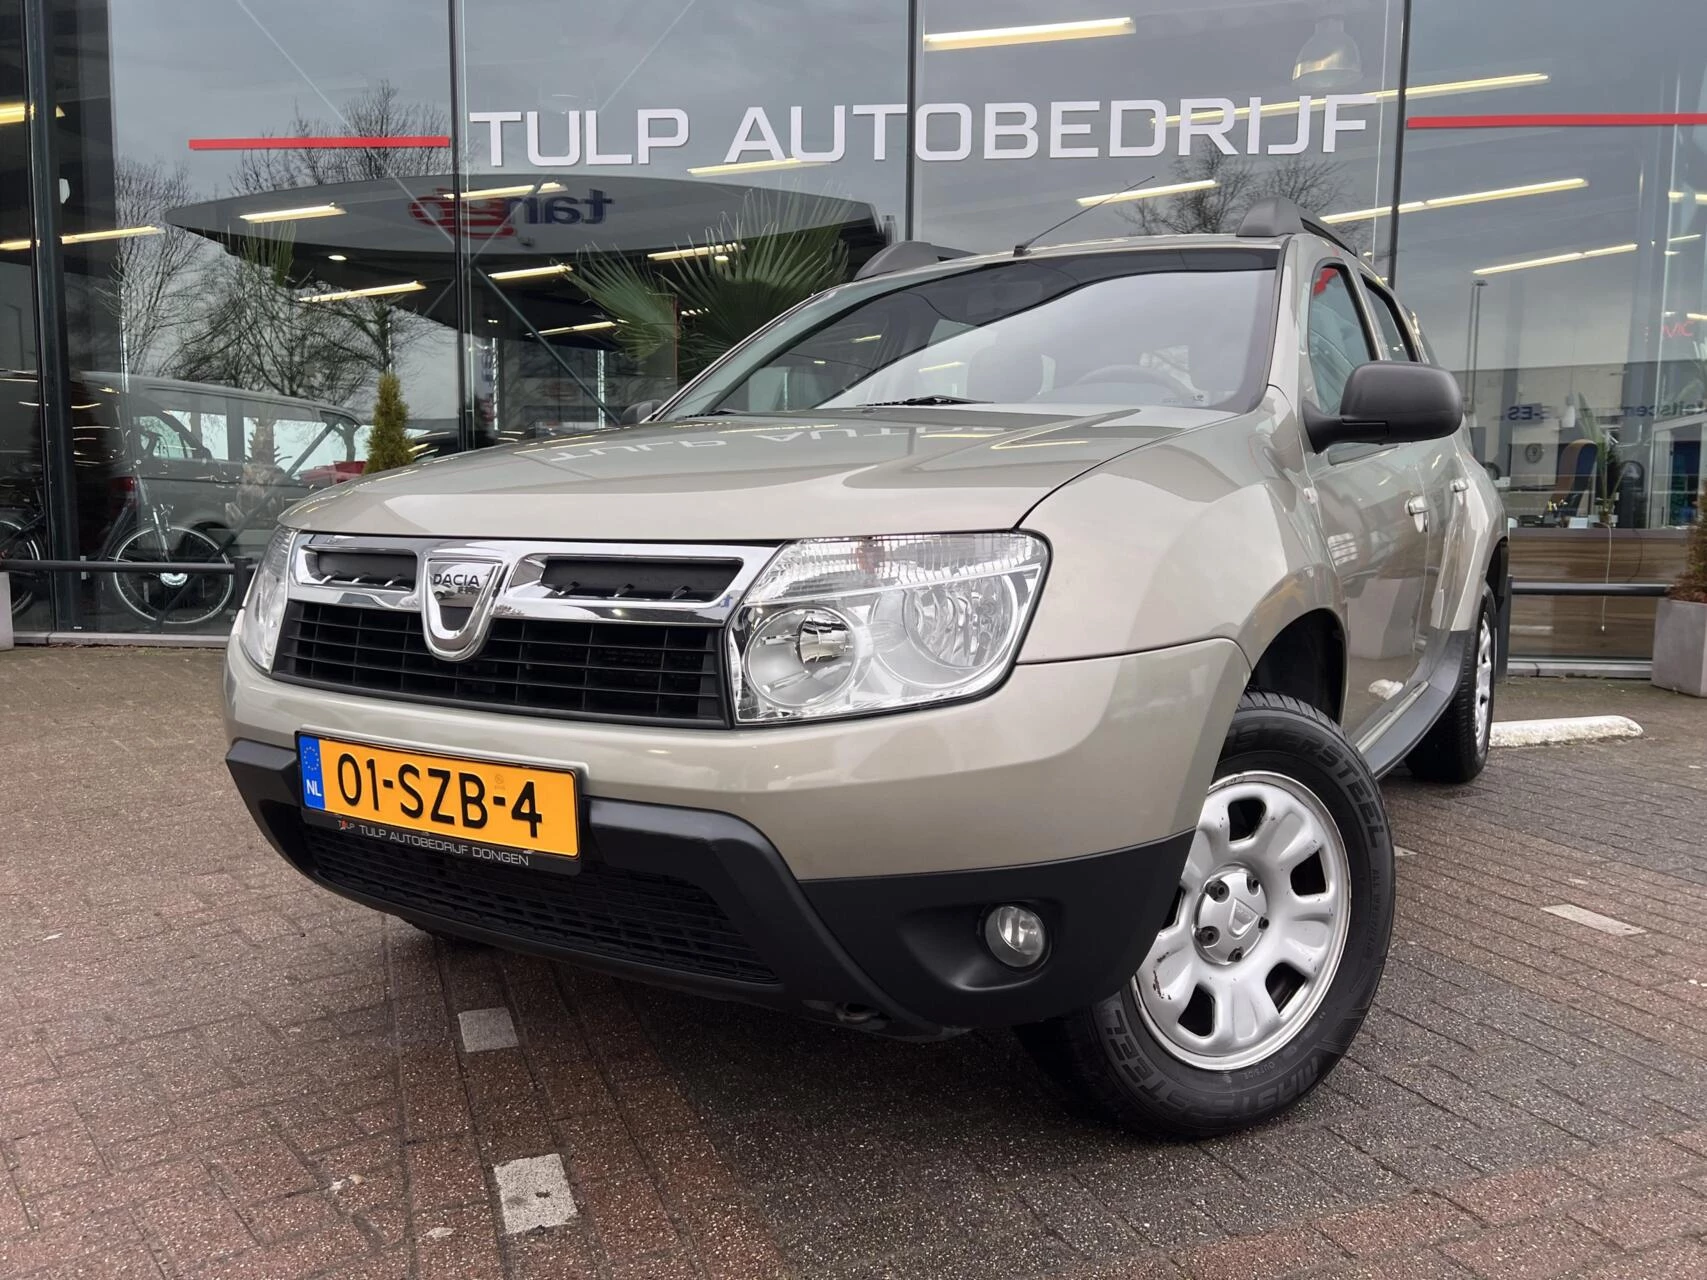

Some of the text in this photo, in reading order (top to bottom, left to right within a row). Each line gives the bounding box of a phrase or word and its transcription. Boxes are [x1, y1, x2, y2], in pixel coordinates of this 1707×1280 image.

[469, 94, 1377, 167] TULP AUTOBEDRIJF
[433, 573, 480, 586] DACIA
[306, 779, 322, 797] NL
[337, 752, 542, 838] 01-SZB-4
[359, 824, 387, 838] TULP
[389, 831, 468, 857] AUTOBEDRIJF
[472, 846, 529, 866] DONGEN
